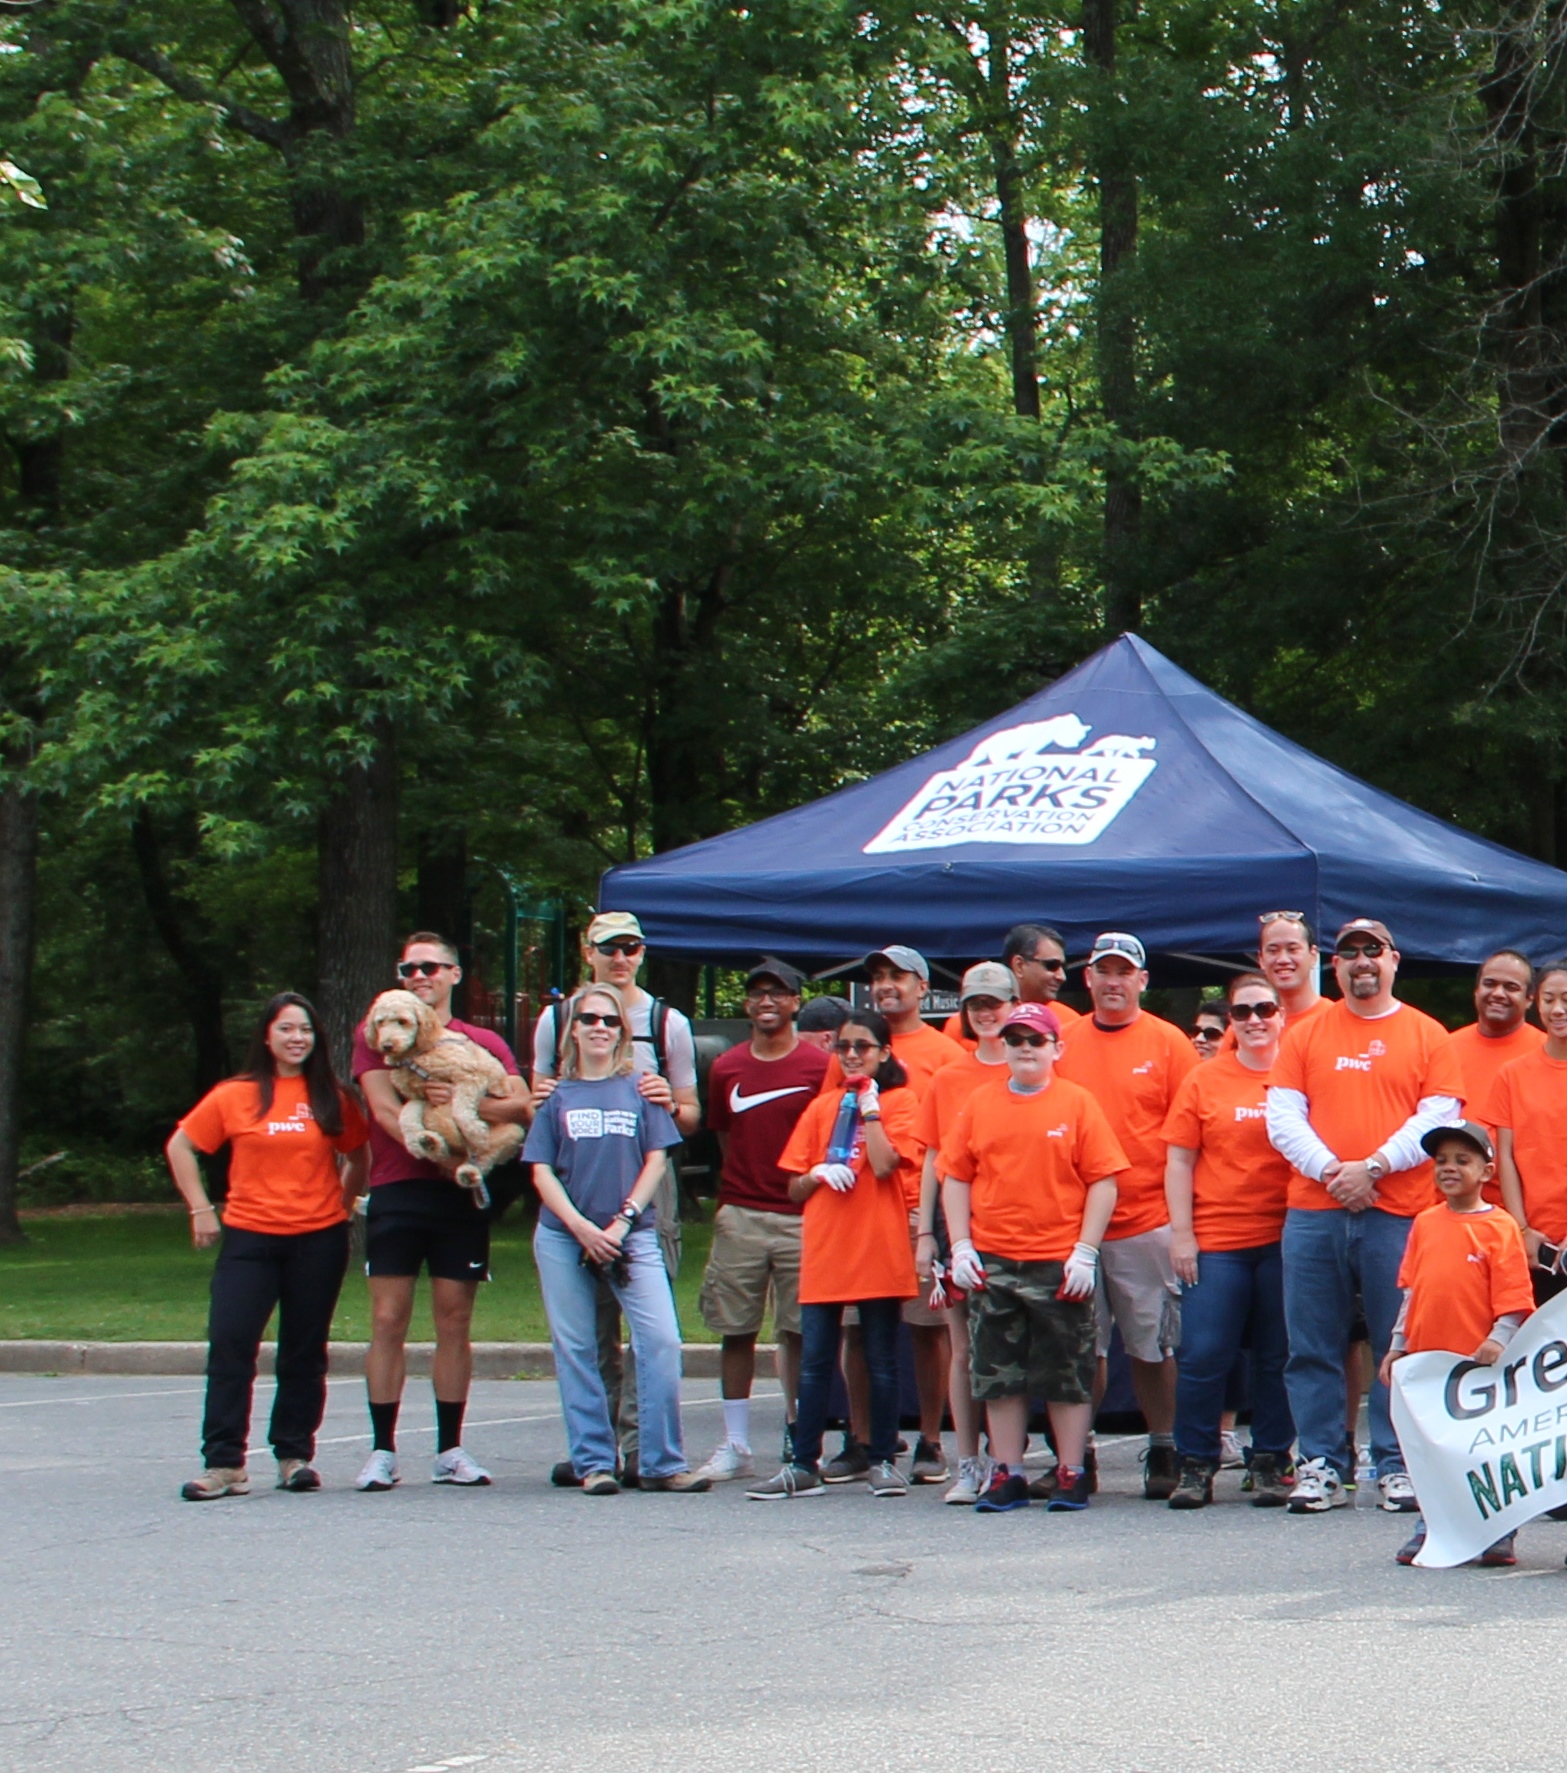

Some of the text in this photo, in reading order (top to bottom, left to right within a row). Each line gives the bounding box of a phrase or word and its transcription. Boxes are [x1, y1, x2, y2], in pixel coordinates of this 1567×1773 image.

[936, 765, 1122, 795] NATIONAL
[913, 784, 1116, 820] PARKS
[902, 808, 1096, 832] CONSERVATION
[888, 821, 1087, 844] ASSOCIATION
[933, 994, 959, 1010] Music
[1335, 1056, 1372, 1072] pwc
[570, 1112, 599, 1120] FIND
[268, 1121, 305, 1136] pwc
[570, 1127, 599, 1135] VOICE
[604, 1124, 635, 1137] Parks
